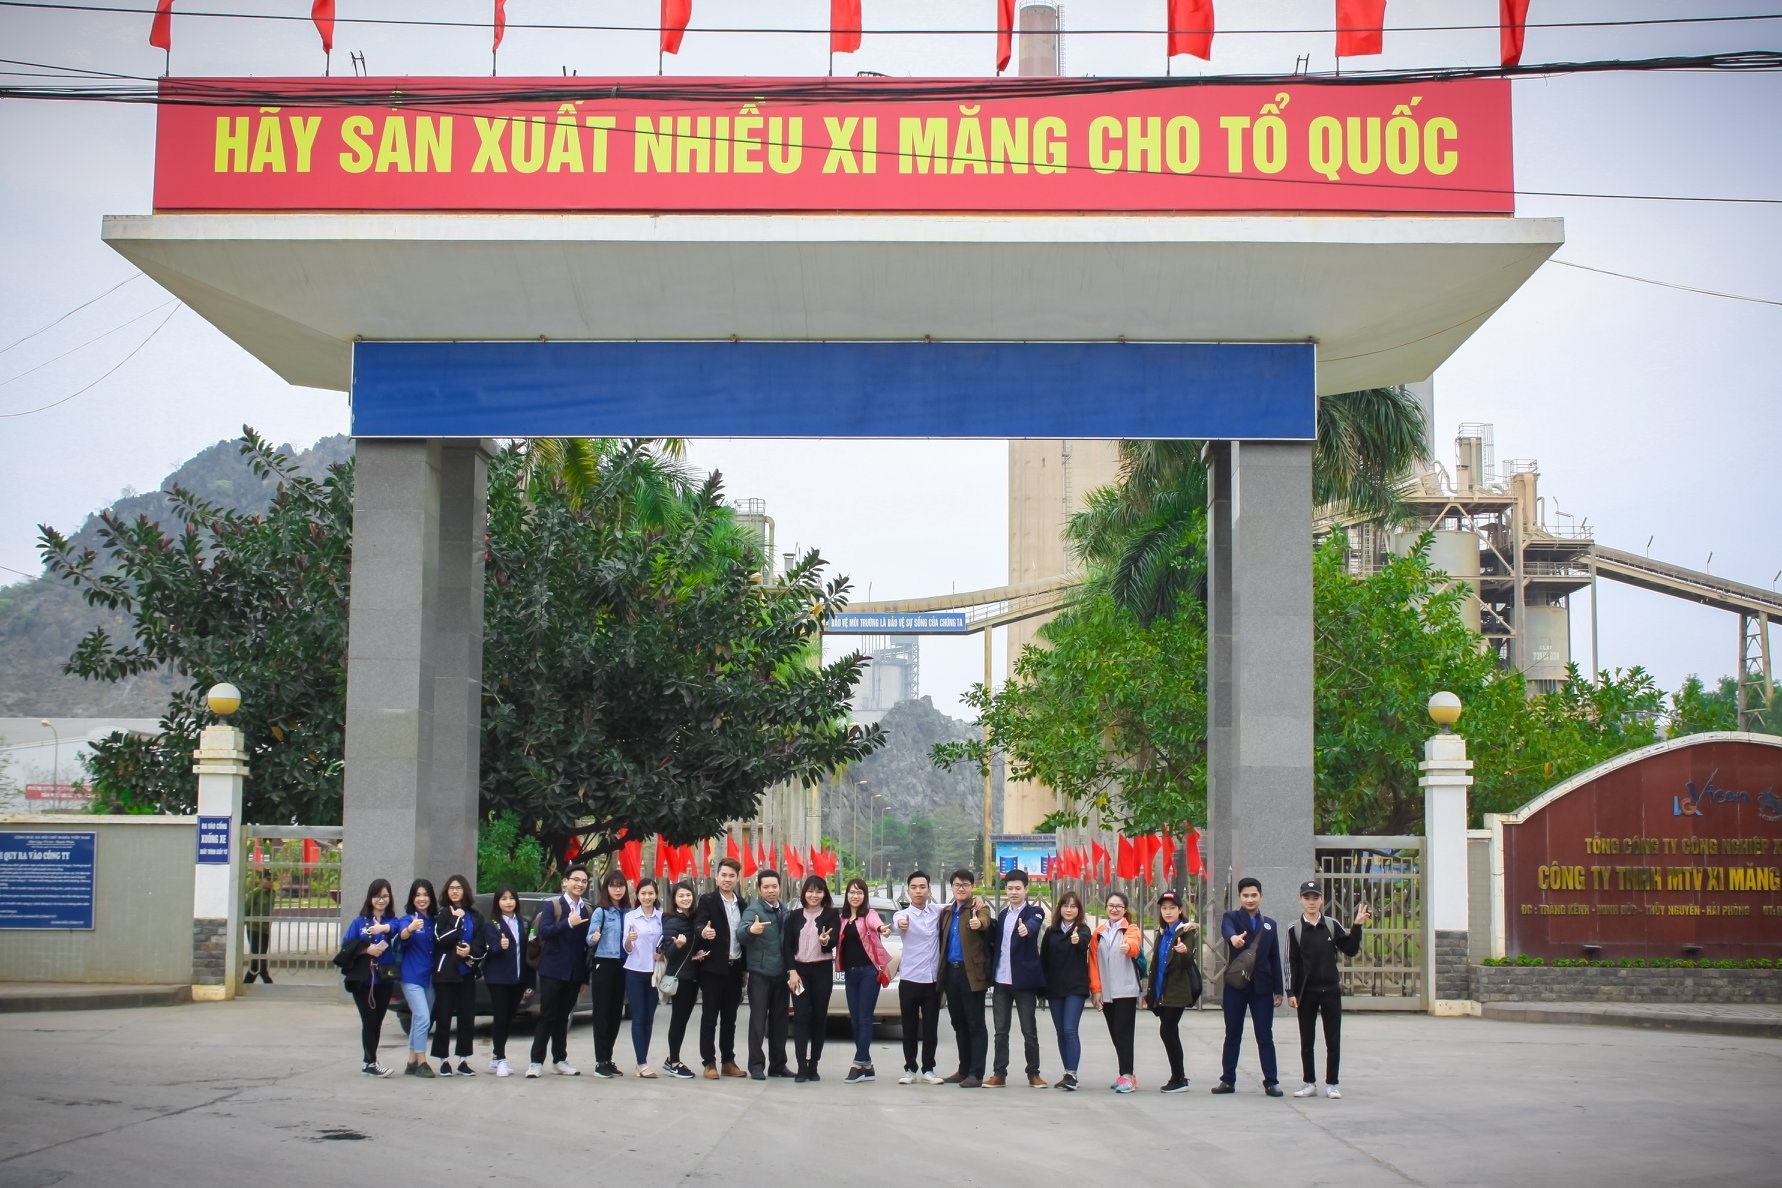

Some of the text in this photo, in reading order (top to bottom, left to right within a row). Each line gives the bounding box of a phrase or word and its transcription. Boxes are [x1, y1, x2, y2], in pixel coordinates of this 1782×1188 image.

[215, 90, 1459, 181] HÃY SẢN XUẤT NHIỀU XI MĂNG CHO TỔ QUỐC
[1584, 831, 1620, 855] TỔNG
[1622, 835, 1659, 855] CÔNG
[1663, 838, 1678, 855] TY
[1681, 835, 1718, 855] CÔNG
[1538, 861, 1781, 891] CÔNG TY TNHH MTV XI MĂNG
